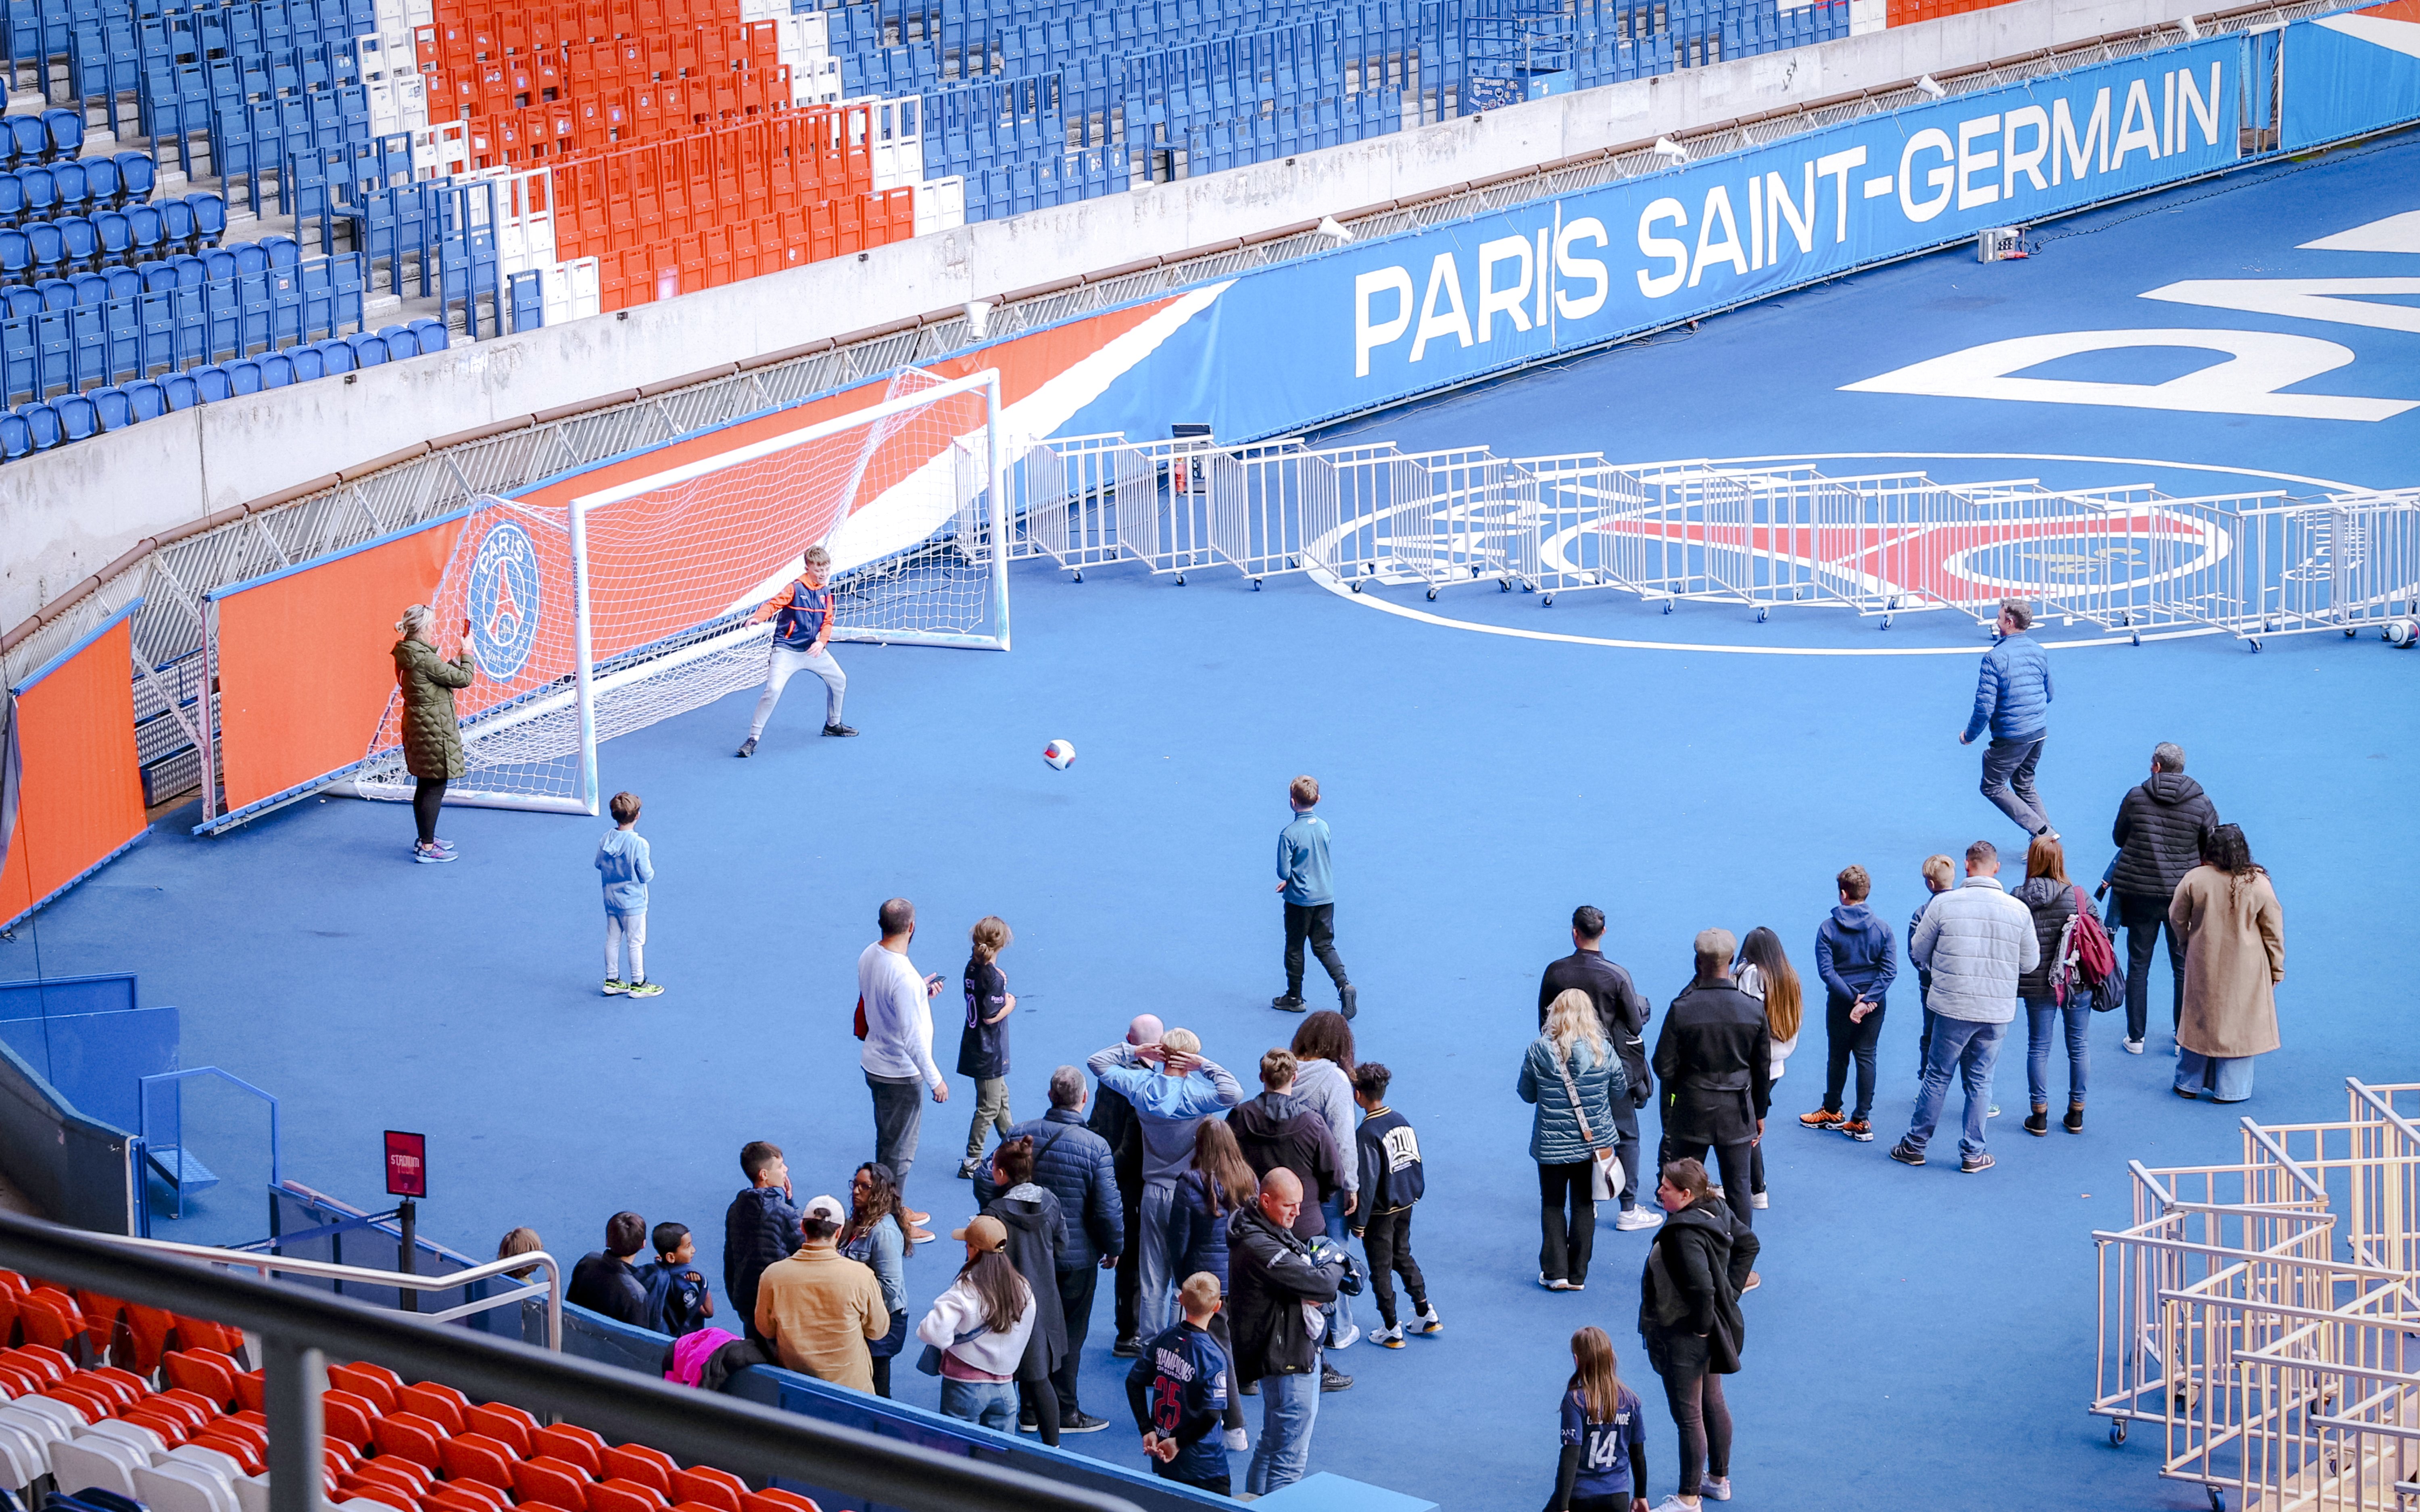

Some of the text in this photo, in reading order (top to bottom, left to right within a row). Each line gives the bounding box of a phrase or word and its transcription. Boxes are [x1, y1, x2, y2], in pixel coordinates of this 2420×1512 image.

[1354, 214, 1609, 378] PARIS
[1635, 60, 2222, 299] SAINT-GERMAIN
[479, 532, 524, 575] PARIS
[390, 1155, 420, 1168] STADIUM
[1382, 1126, 1421, 1175] BOSTON
[1156, 1347, 1195, 1382] CHAMPIONS
[1154, 1376, 1181, 1430] 25
[1588, 1431, 1617, 1469] 14
